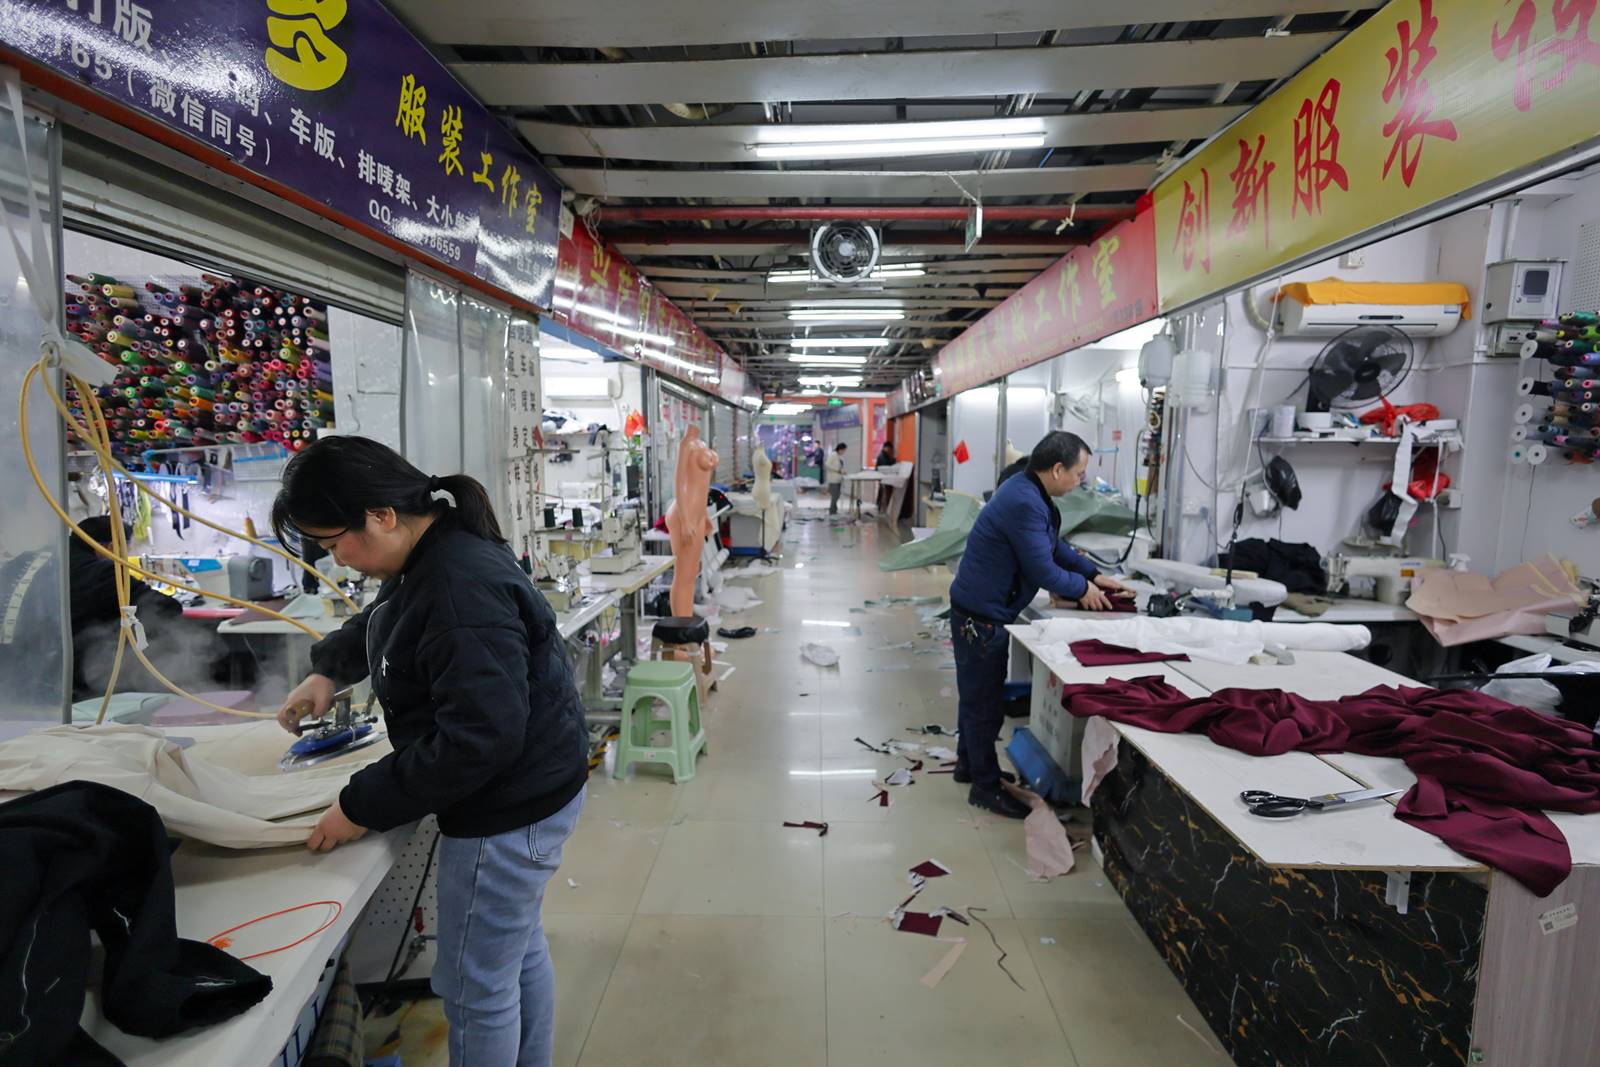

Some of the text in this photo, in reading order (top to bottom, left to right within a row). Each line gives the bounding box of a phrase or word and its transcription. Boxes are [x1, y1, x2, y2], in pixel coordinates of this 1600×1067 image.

[396, 73, 543, 234] 服装工作室
